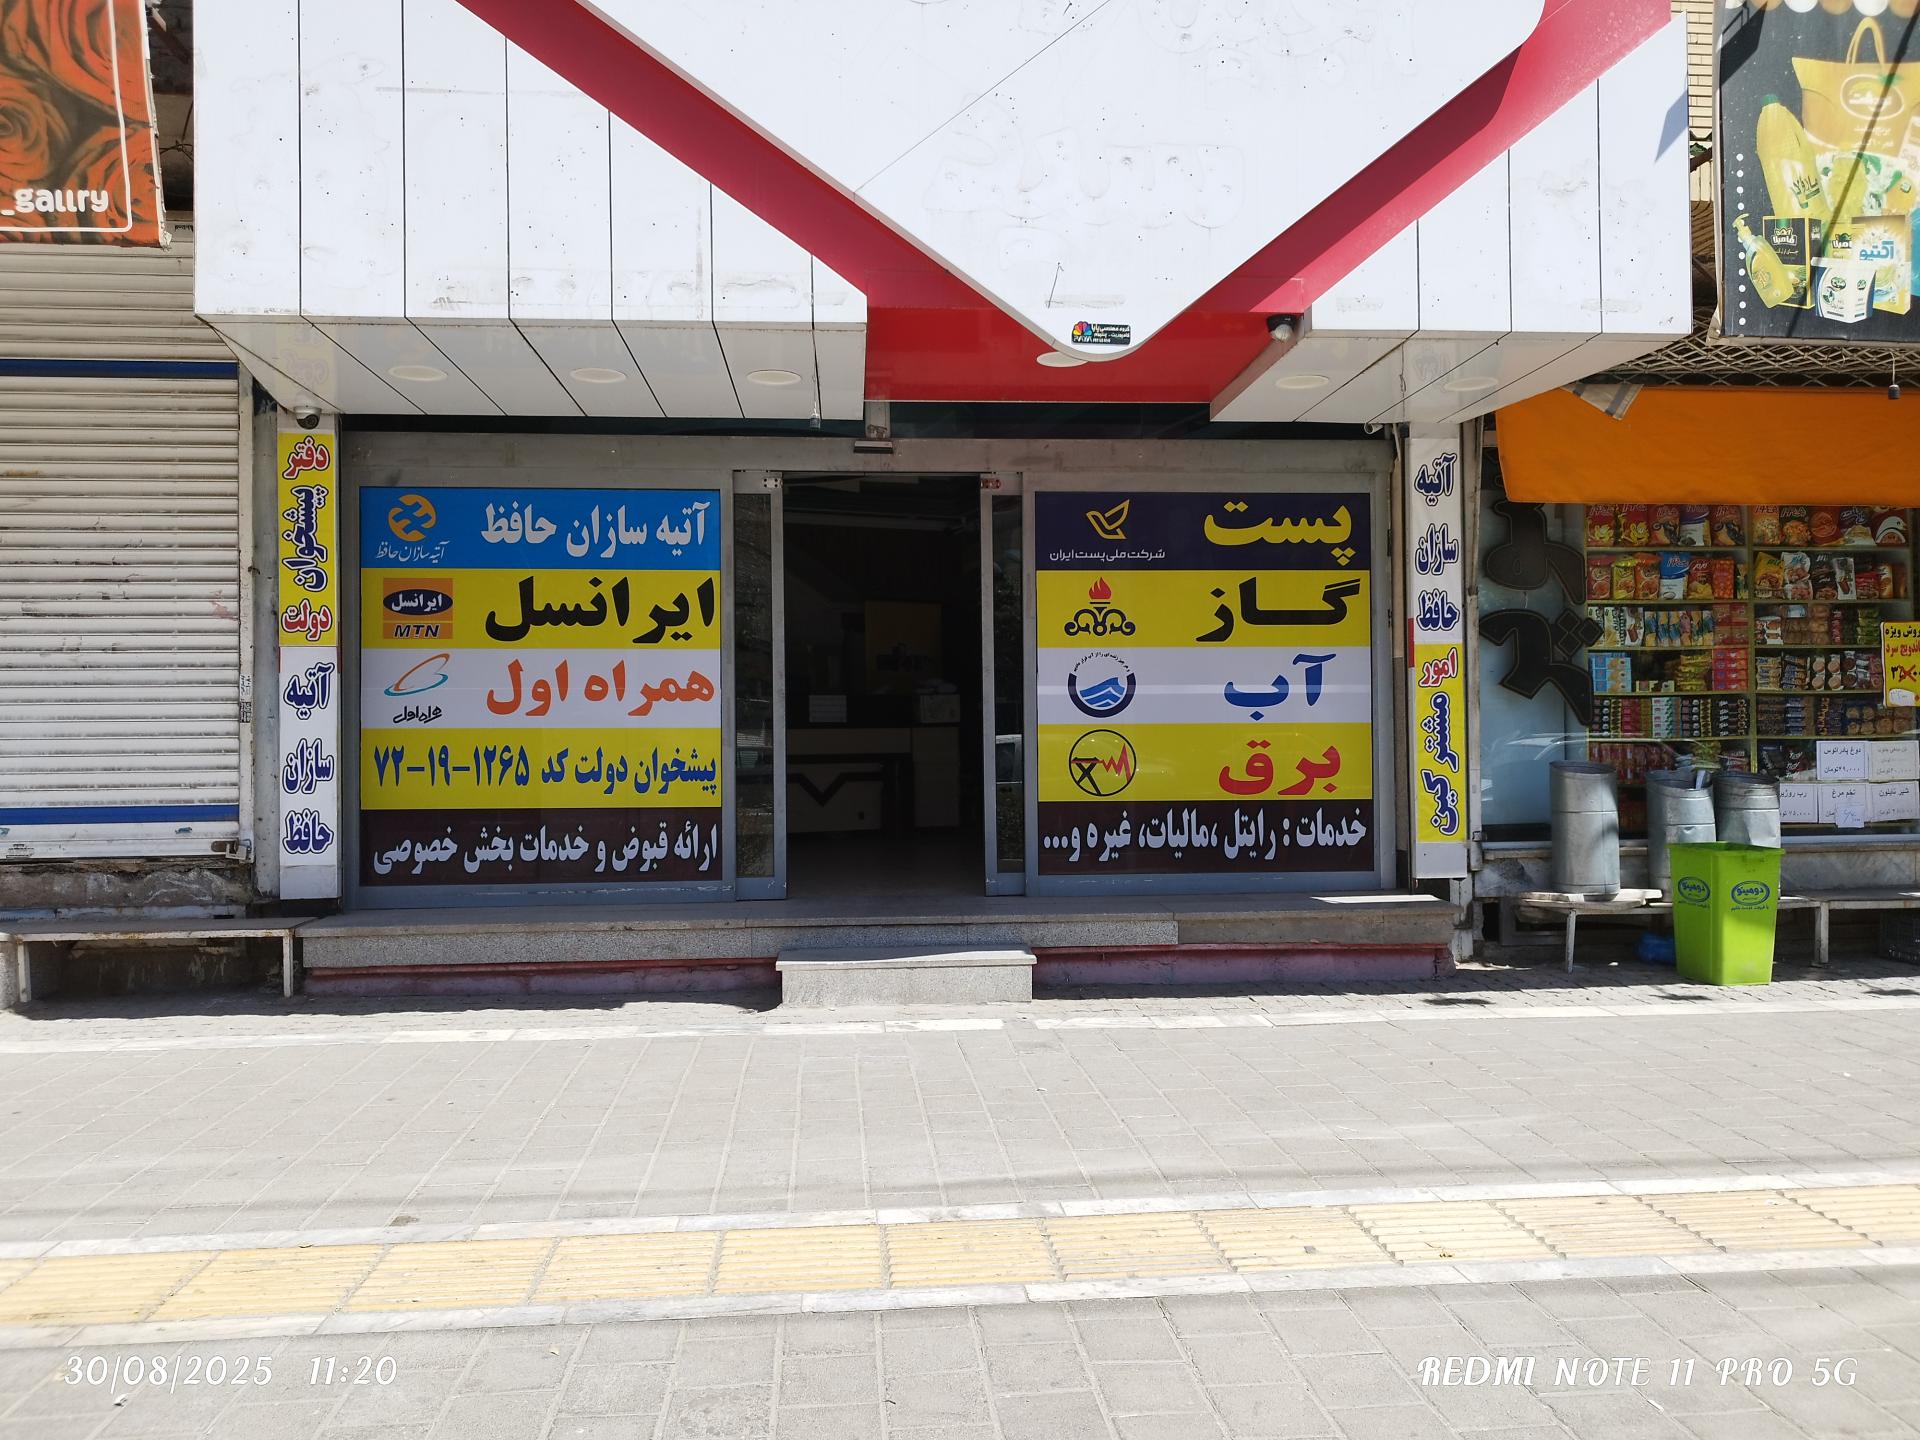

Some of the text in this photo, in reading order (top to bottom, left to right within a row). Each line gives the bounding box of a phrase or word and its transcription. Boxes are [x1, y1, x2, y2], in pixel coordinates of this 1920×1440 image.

[282, 436, 330, 480] دفتر
[1414, 453, 1458, 506] آتیه
[282, 484, 329, 592] پیشخوان
[376, 541, 450, 563] آتیه سازان حافظ
[480, 500, 711, 559] آتیه سازان حافظ
[1049, 548, 1165, 562] شرکت ملی پست ایران
[1203, 500, 1356, 566] پست
[1415, 523, 1460, 575] سازان
[281, 598, 332, 641] دولت
[391, 593, 443, 612] ایرانسل
[485, 576, 715, 644] ایرانسل
[1196, 576, 1361, 642] گاز
[1416, 588, 1460, 631] حافظ
[393, 624, 440, 639] MTN
[283, 662, 335, 720] آتیه
[486, 658, 716, 717] همراه اول
[1224, 653, 1337, 721] آب
[1418, 646, 1458, 688] امور
[282, 737, 335, 794] سازان
[541, 747, 569, 784] کد
[575, 746, 628, 794] دولت
[634, 746, 717, 796] پیشخوان
[1218, 740, 1341, 796] برق
[282, 808, 335, 854] حافظ
[373, 819, 718, 875] ارائه قبوض و خدمات بخش خصوصی
[1087, 810, 1132, 862] غیره
